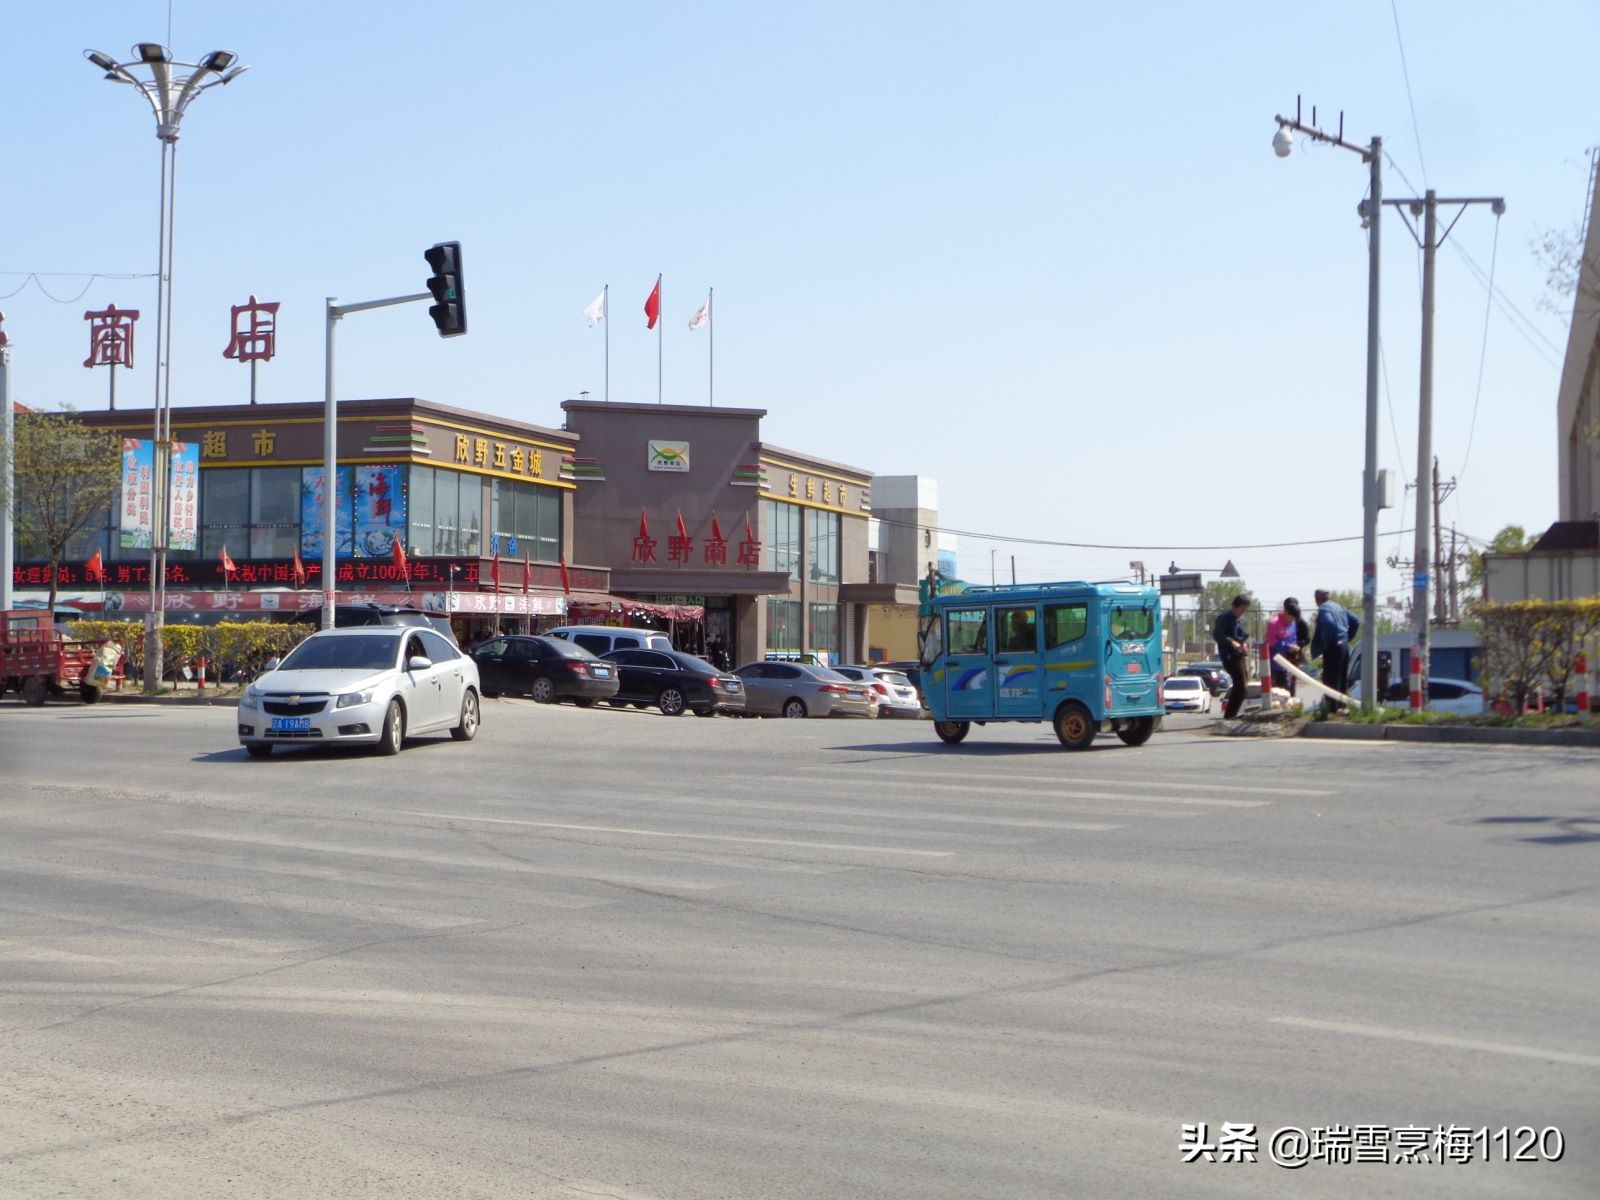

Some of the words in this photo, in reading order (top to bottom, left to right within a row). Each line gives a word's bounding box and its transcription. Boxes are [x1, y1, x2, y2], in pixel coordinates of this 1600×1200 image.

[455, 433, 543, 475] 欣野五金城
[788, 473, 847, 504] 生鲜超市
[632, 535, 761, 566] 欣野商店
[164, 593, 245, 608] 欣野
